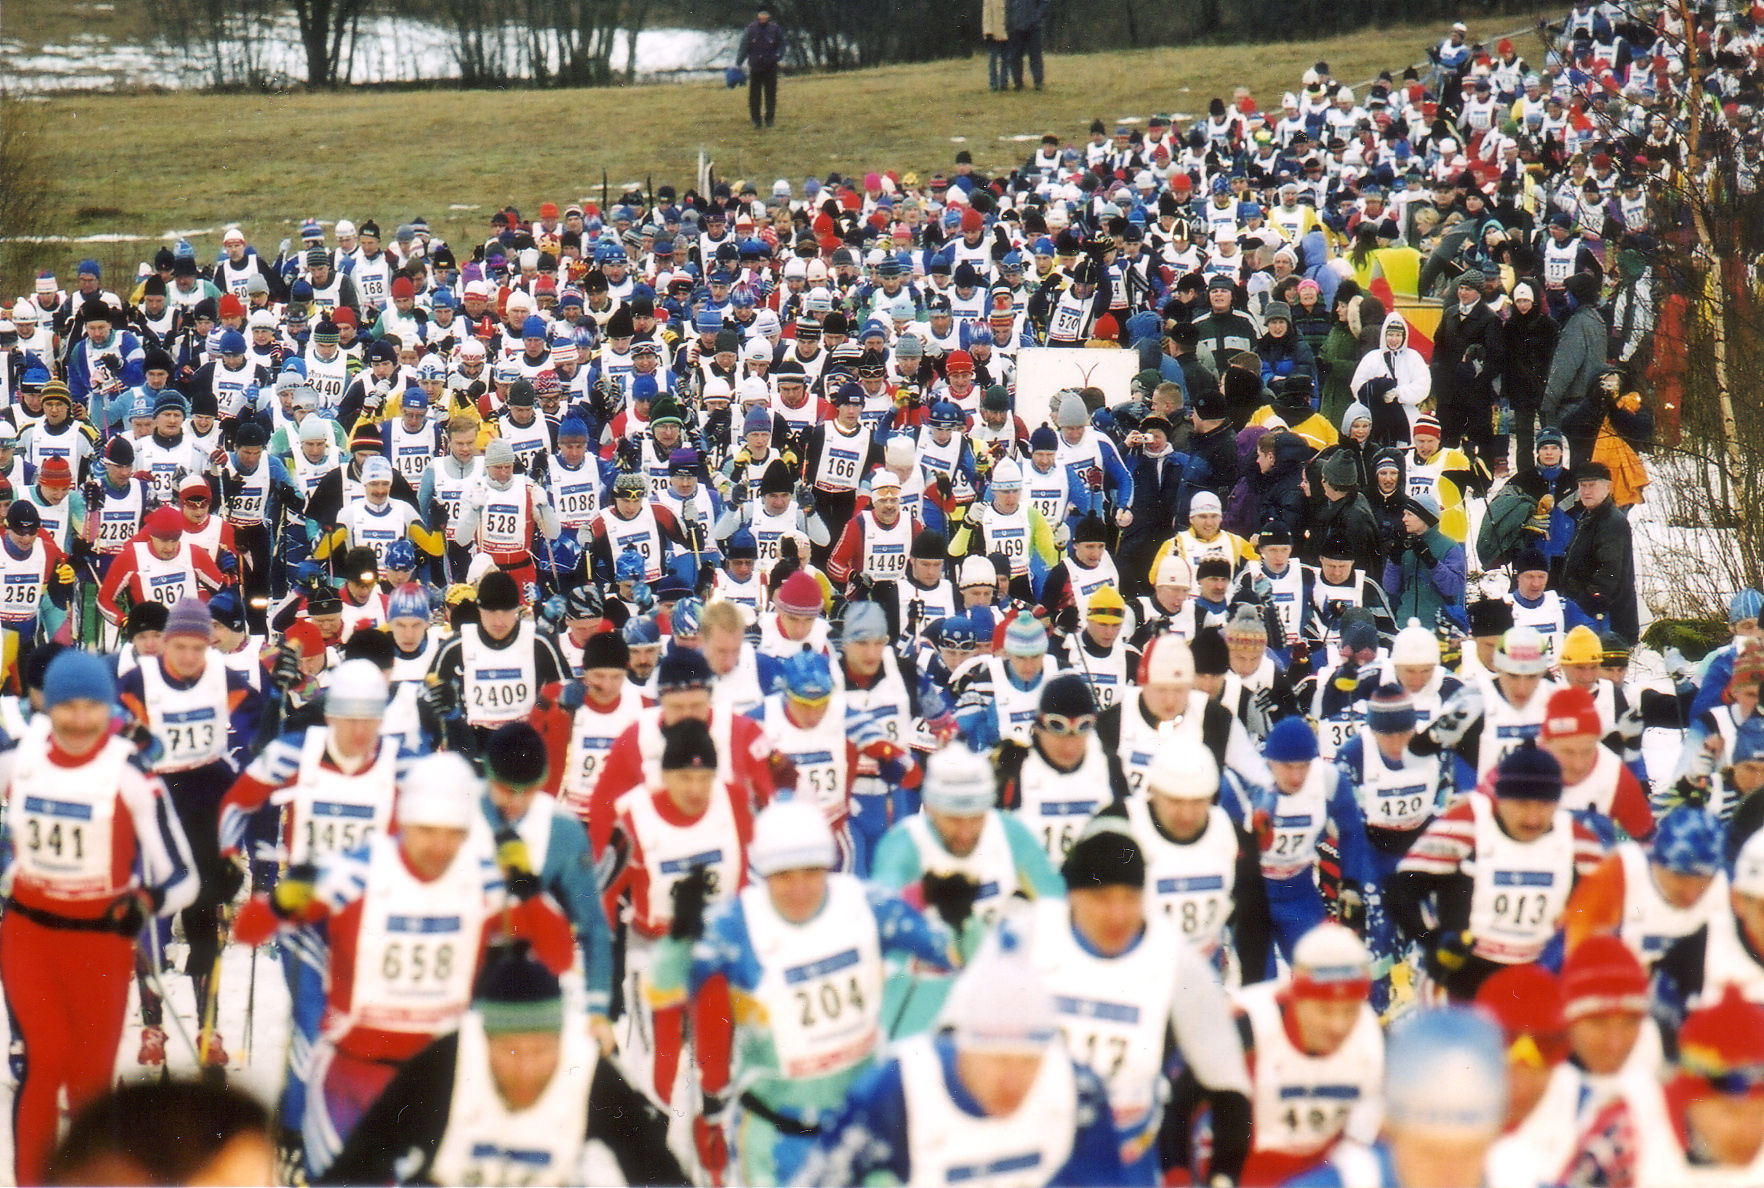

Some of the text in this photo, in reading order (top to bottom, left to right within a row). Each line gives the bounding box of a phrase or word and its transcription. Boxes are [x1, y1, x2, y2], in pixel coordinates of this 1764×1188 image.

[363, 281, 383, 295] 168
[219, 391, 233, 407] 74
[827, 457, 856, 478] 166
[153, 473, 171, 490] 63
[226, 497, 262, 513] 864
[559, 494, 595, 513] 1088
[99, 522, 135, 540] 2286
[487, 514, 516, 534] 528
[758, 542, 777, 559] 76
[995, 539, 1023, 557] 469
[867, 554, 906, 571] 1449
[5, 586, 36, 603] 256
[473, 683, 528, 707] 2409
[167, 724, 214, 752] 713
[809, 768, 837, 793] 53
[1380, 796, 1422, 816] 420
[27, 818, 83, 860] 341
[1043, 824, 1073, 853] 16
[1276, 834, 1305, 855] 27
[1495, 894, 1548, 926] 913
[381, 941, 454, 980] 658
[796, 976, 865, 1027] 204
